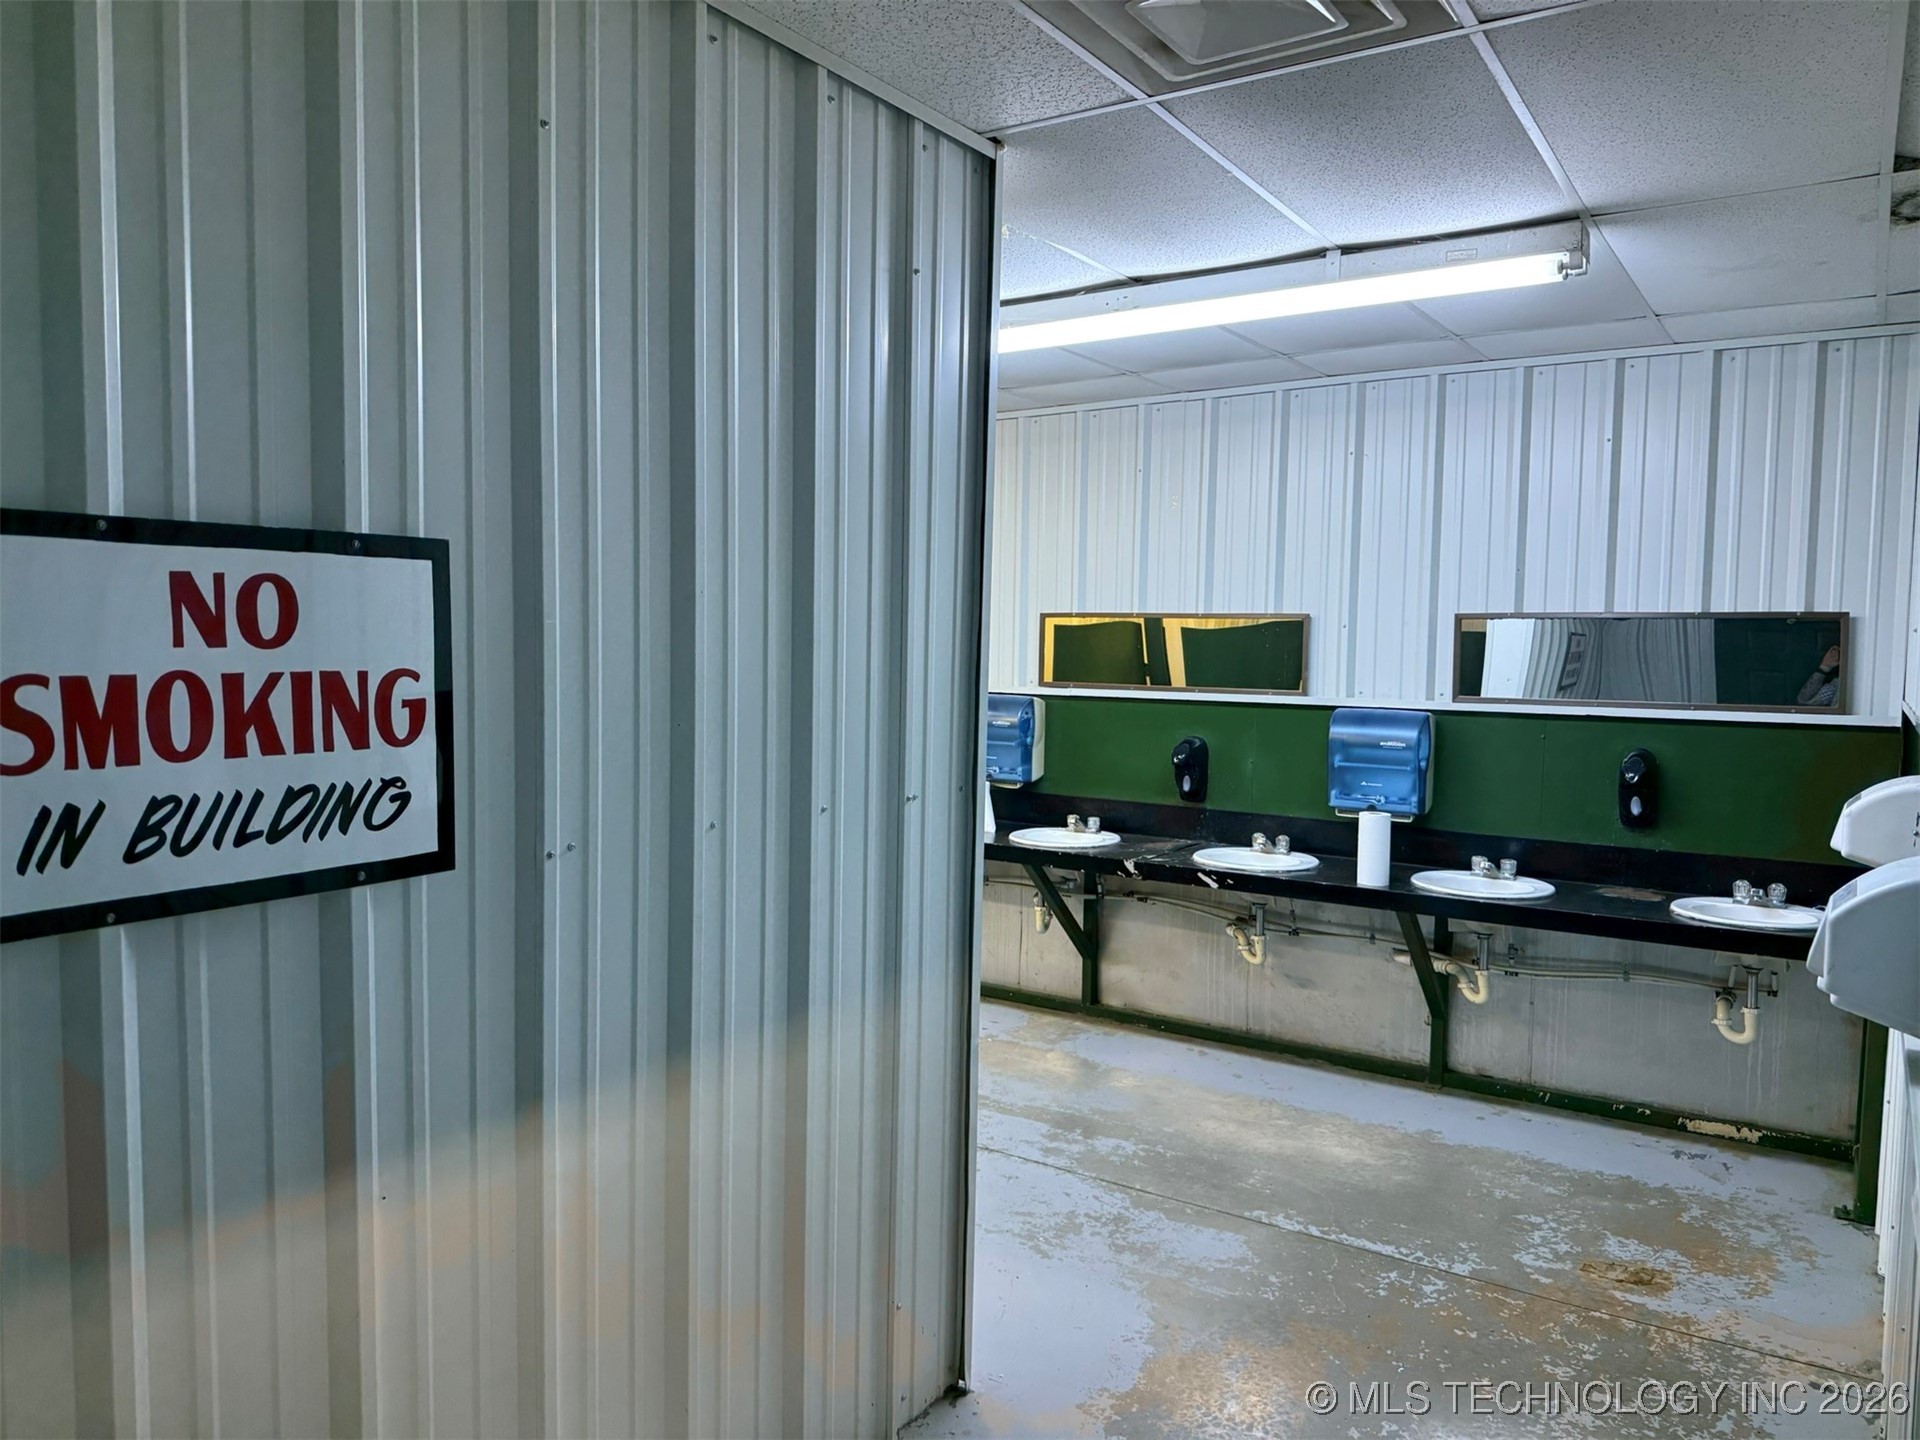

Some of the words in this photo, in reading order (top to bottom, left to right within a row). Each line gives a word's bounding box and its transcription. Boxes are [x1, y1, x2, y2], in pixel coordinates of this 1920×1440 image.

[169, 571, 299, 650] NO
[0, 668, 427, 777] SMOKING
[16, 799, 106, 877] IN
[122, 776, 412, 864] BUILDING
